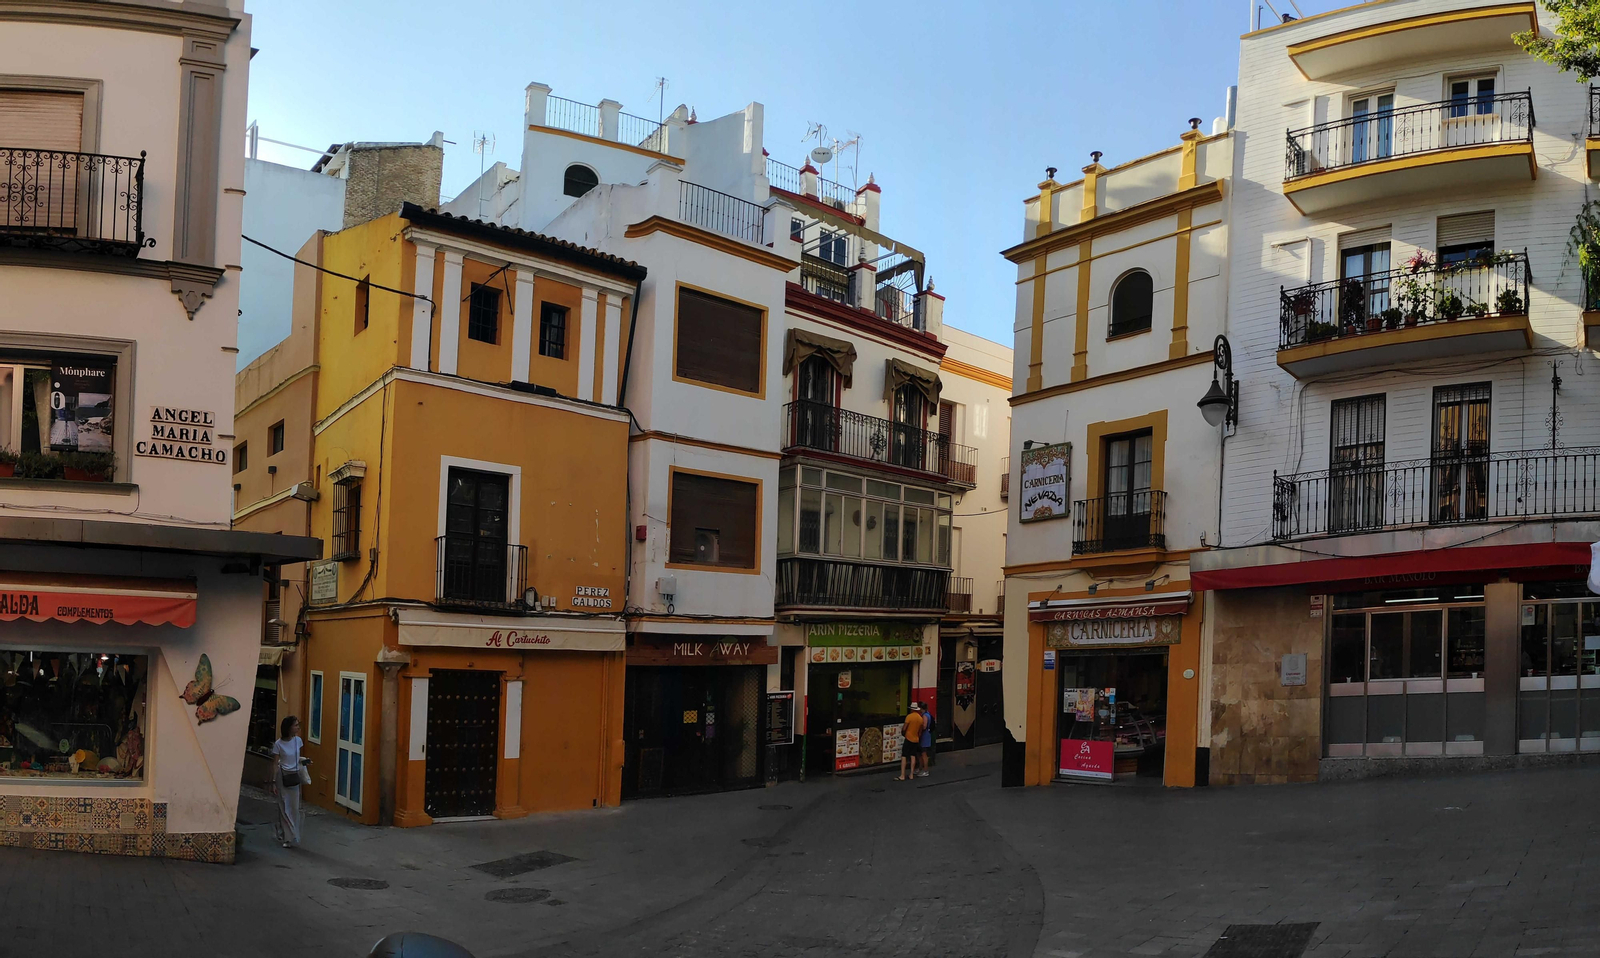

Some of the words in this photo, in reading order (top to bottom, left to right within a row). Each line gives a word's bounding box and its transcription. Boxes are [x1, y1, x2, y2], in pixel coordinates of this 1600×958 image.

[152, 407, 213, 425] ANGEL
[152, 424, 211, 442] MARIA
[136, 441, 226, 463] CAMACHO
[1024, 473, 1065, 489] CARNICERIA
[1024, 490, 1064, 511] NEVADA
[577, 586, 609, 597] PEREZ
[572, 597, 612, 608] GALDOS
[57, 606, 114, 619] COMPLEMENTOS
[1054, 608, 1101, 620] CARNICAS
[1105, 606, 1156, 616] ALMANSA
[809, 624, 835, 636] ARIN
[837, 624, 880, 636] PIZZERIA
[1070, 619, 1153, 640] CARNICERIA
[485, 630, 503, 647] Al
[506, 630, 551, 647] Cartuchito
[673, 642, 703, 656] MILK
